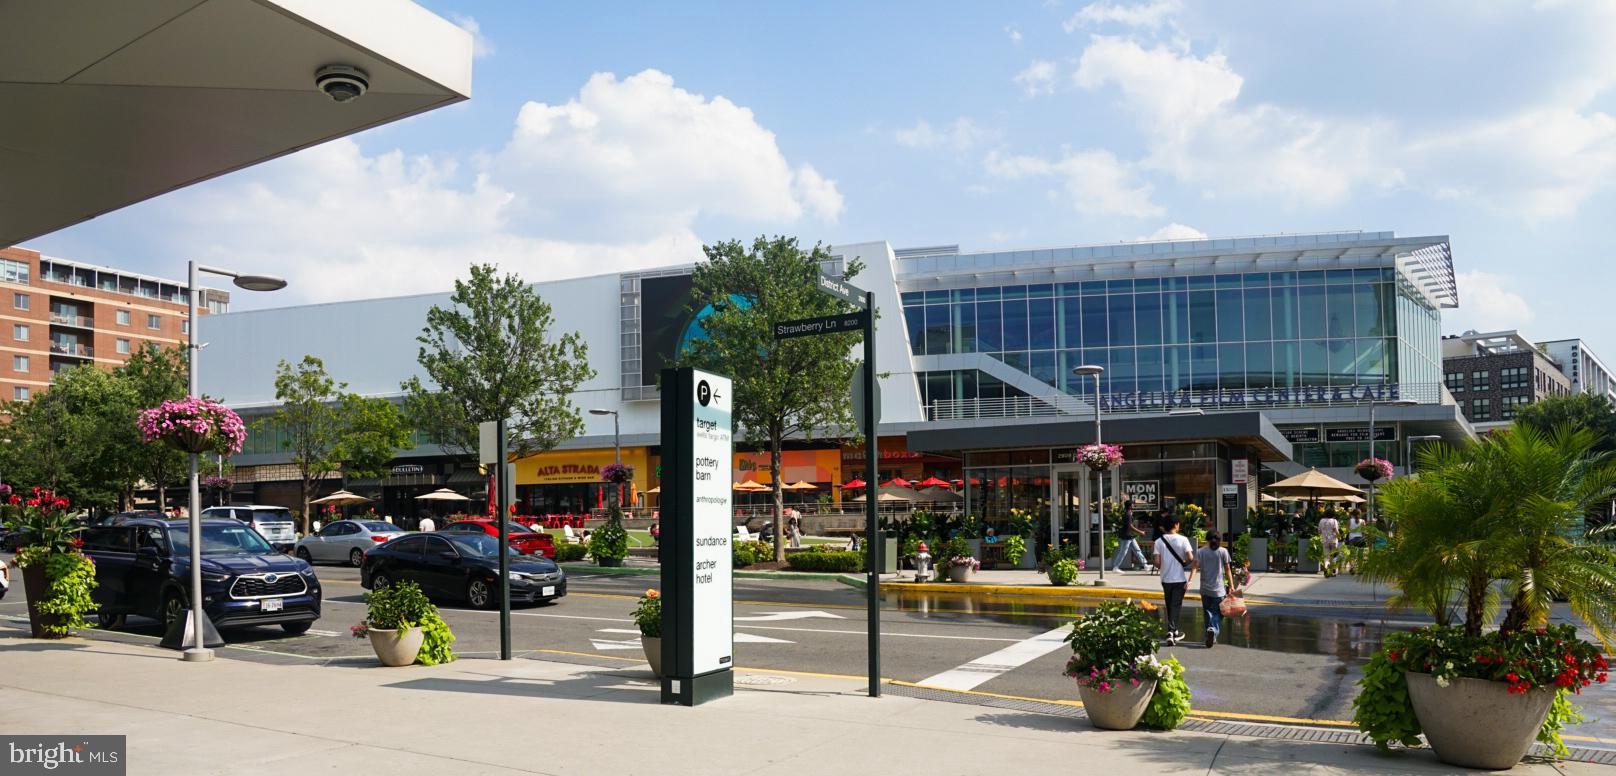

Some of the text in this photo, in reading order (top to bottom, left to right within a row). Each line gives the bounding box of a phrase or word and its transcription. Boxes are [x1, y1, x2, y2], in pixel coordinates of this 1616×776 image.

[820, 275, 849, 296] District Ave
[777, 321, 823, 335] Strawberry
[825, 319, 837, 329] Ln
[1100, 390, 1191, 409] ANGELIKA
[1201, 390, 1245, 406] FILM
[1253, 387, 1326, 403] CENTER
[1332, 387, 1343, 401] &
[696, 417, 717, 432] target
[696, 457, 719, 470] pottery
[537, 464, 600, 477] ALTA STRADA
[696, 469, 711, 481] barn
[1126, 484, 1155, 493] MOM
[696, 536, 727, 547] sundance
[696, 560, 716, 571] archer
[696, 573, 713, 584] hotel
